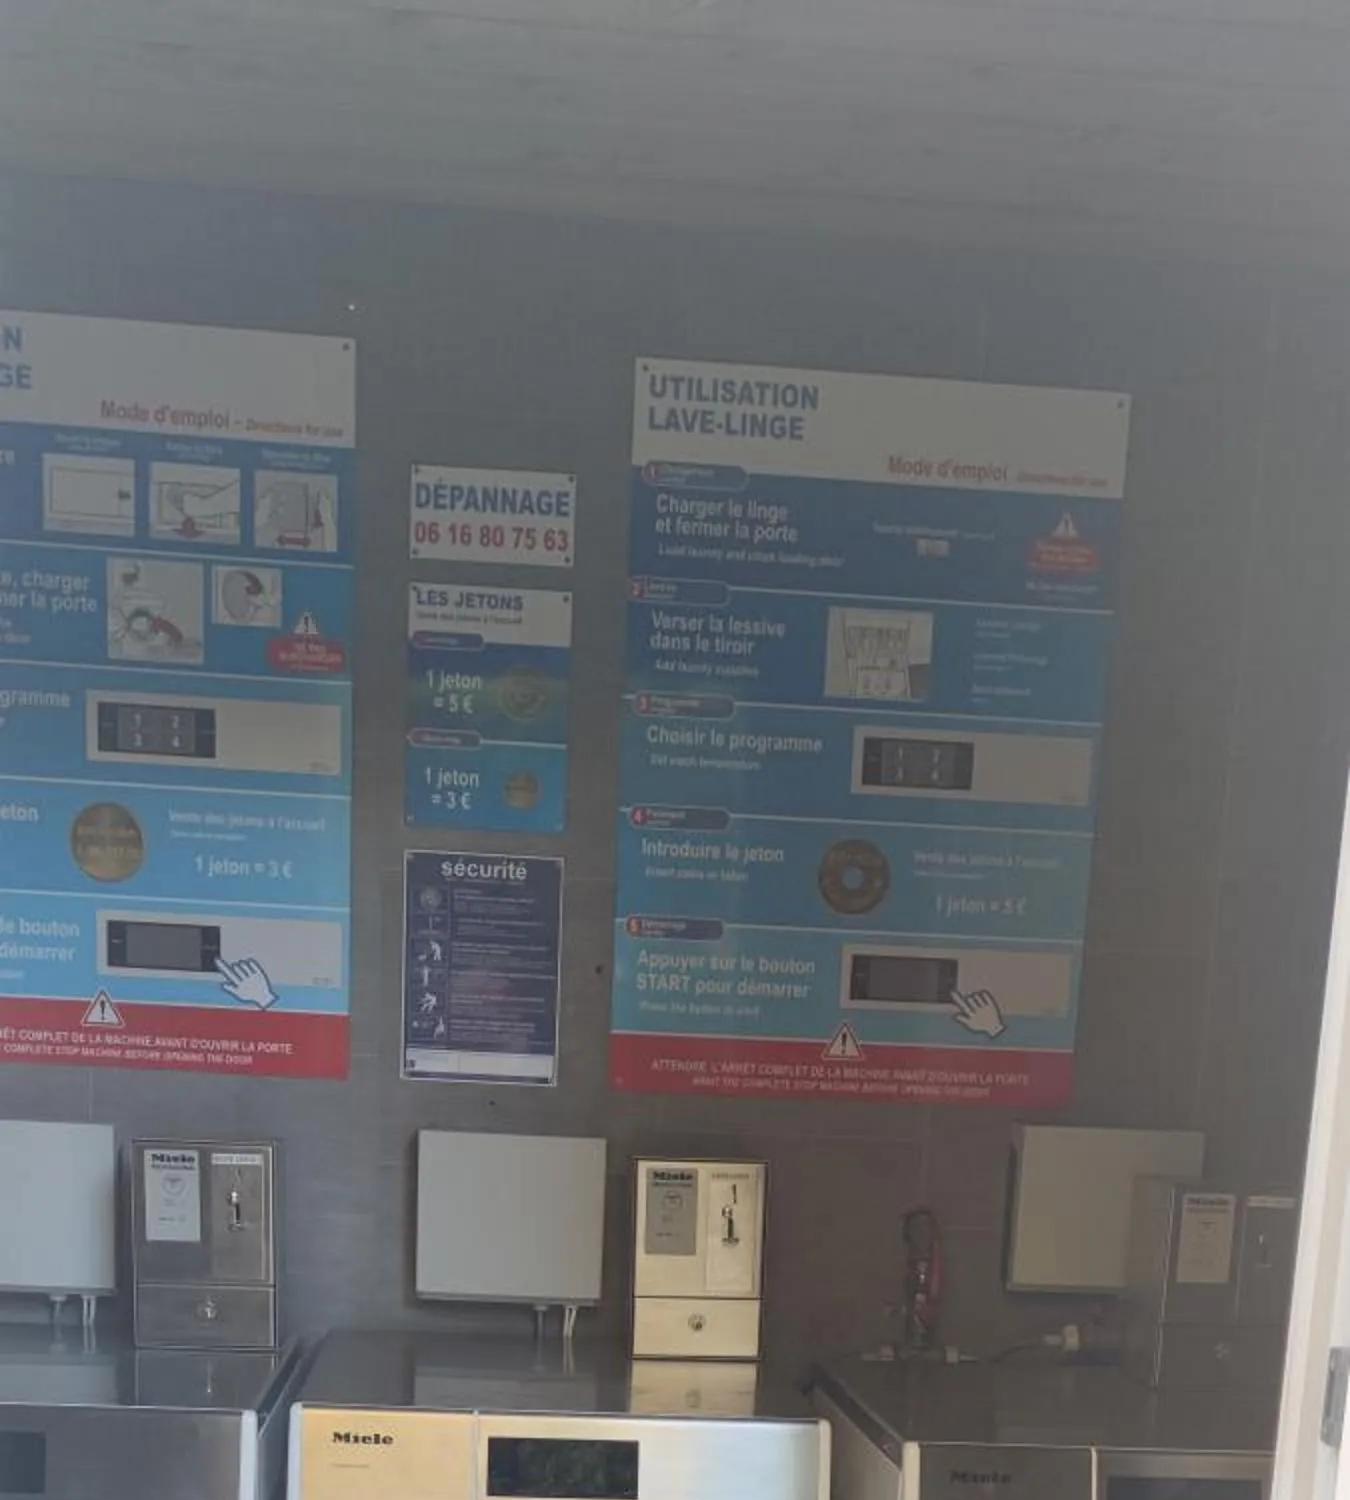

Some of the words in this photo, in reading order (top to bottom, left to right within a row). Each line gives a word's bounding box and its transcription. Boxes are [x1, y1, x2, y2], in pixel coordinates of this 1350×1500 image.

[649, 374, 819, 410] UTILISATION
[100, 400, 149, 423] Mode
[153, 403, 230, 430] d'emploi
[648, 406, 805, 441] LAVE-LINGE
[889, 455, 932, 477] Mode
[937, 457, 1009, 483] d'emploi
[415, 479, 571, 518] DÉPANNAGE
[656, 493, 724, 520] Charger
[728, 498, 743, 519] le
[747, 498, 789, 523] linge
[414, 521, 441, 545] 06
[448, 523, 472, 547] 16
[479, 524, 505, 548] 80
[512, 526, 537, 550] 75
[543, 528, 569, 552] 63
[655, 517, 672, 535] et
[675, 516, 731, 537] fermer
[735, 519, 750, 538] la
[753, 524, 799, 544] porte
[22, 571, 91, 595] charger
[31, 591, 46, 609] la
[50, 596, 97, 614] porte
[416, 589, 449, 607] LES
[454, 591, 524, 612] JETONS
[651, 608, 704, 632] Verser
[709, 613, 724, 633] la
[728, 614, 786, 638] lessive
[649, 631, 691, 650] dans
[694, 633, 709, 653] le
[714, 634, 757, 656] tiroir
[426, 670, 433, 689] 1
[439, 671, 482, 692] jeton
[646, 724, 707, 746] Choisir
[710, 727, 725, 747] le
[729, 732, 823, 756] programme
[426, 767, 432, 784] 1
[437, 768, 480, 789] jeton
[447, 791, 457, 810] 3
[632, 810, 642, 823] 4
[641, 837, 720, 860] Introduire
[724, 842, 739, 861] le
[743, 845, 784, 867] jeton
[194, 854, 202, 872] 1
[207, 855, 250, 877] jeton
[268, 859, 279, 879] 3
[440, 857, 529, 881] sécurité
[19, 917, 80, 938] bouton
[637, 948, 704, 974] Appuyer
[709, 955, 737, 972] sur
[740, 954, 755, 972] le
[758, 956, 816, 975] bouton
[635, 973, 691, 994] START
[695, 979, 732, 996] pour
[736, 976, 811, 999] démarrer
[18, 1029, 69, 1043] COMPLET
[71, 1032, 87, 1044] DE
[105, 1035, 151, 1048] MACHINE
[258, 1042, 294, 1056] PORTE
[151, 1153, 195, 1164] Miele
[653, 1171, 694, 1181] Miele
[331, 1430, 396, 1446] Miele
[950, 1469, 1012, 1484] Miele
